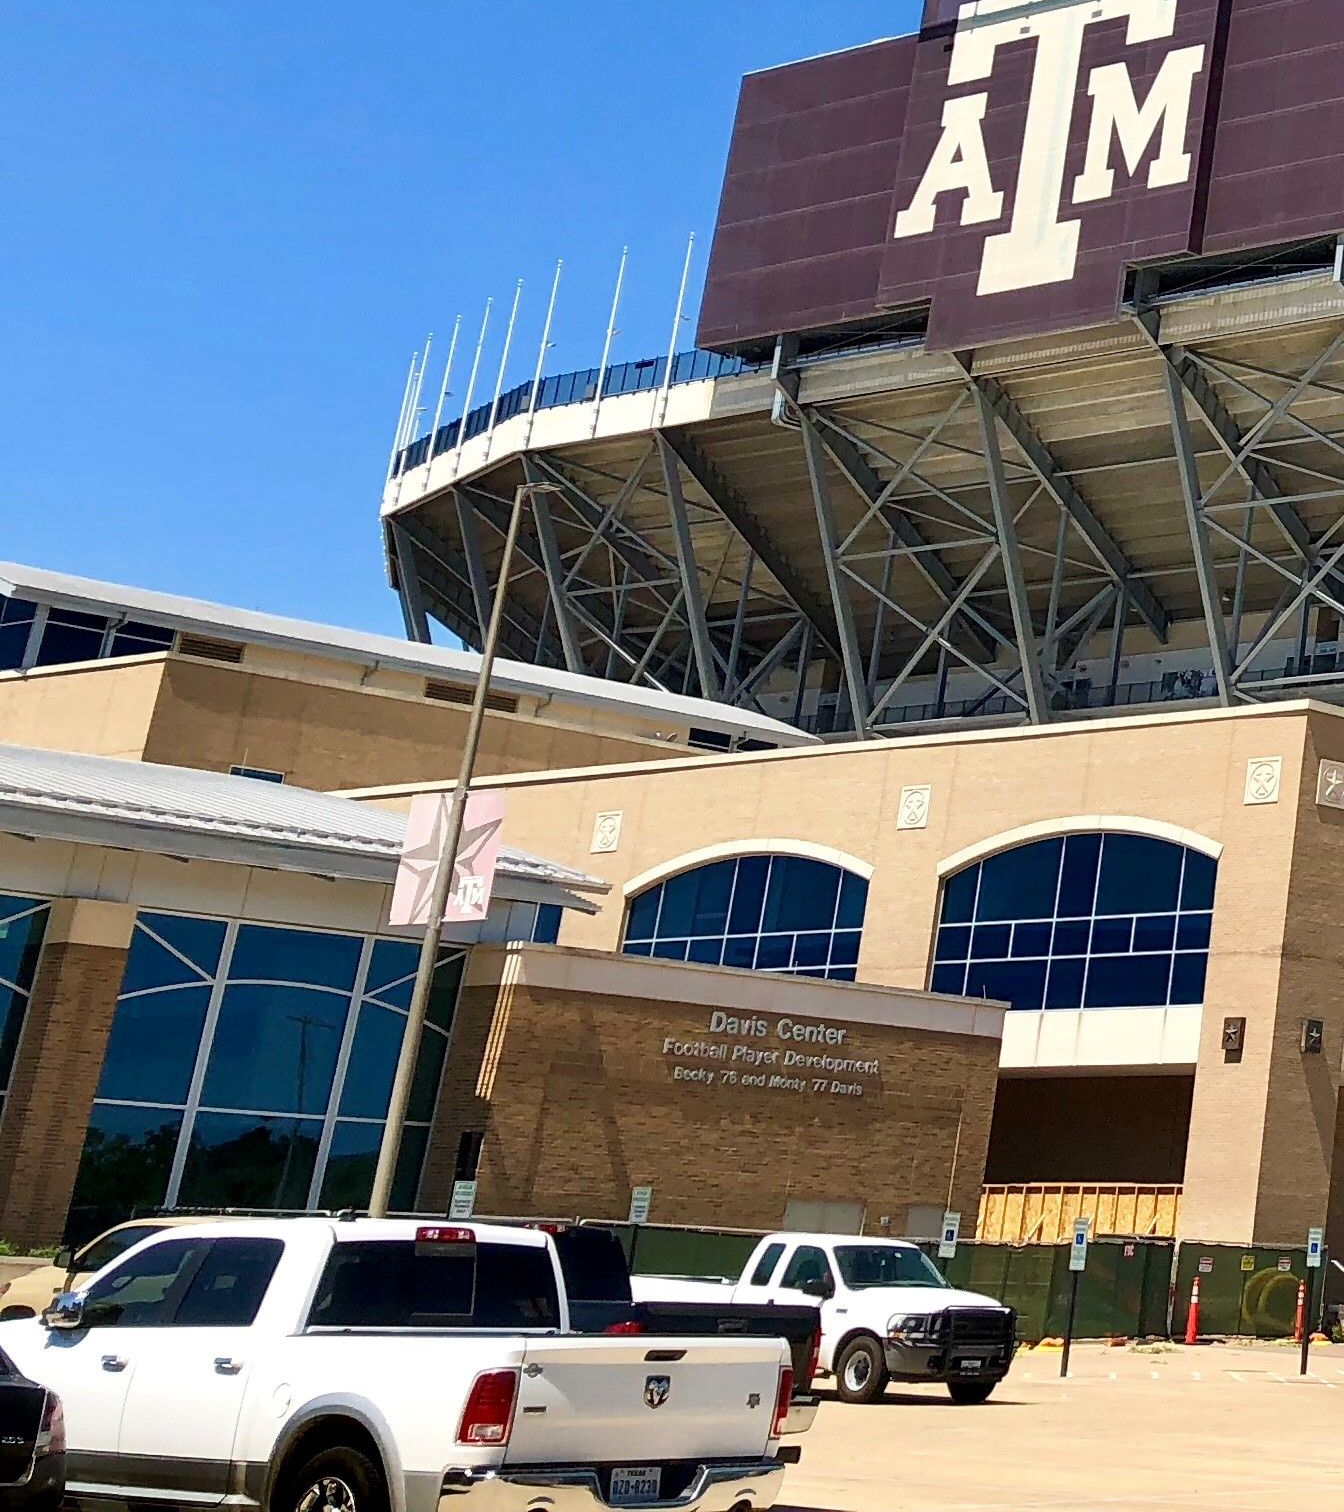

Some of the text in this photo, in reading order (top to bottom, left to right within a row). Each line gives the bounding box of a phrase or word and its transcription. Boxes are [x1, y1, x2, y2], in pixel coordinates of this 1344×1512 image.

[709, 1011, 847, 1045] Davis Center
[662, 1038, 879, 1074] Football Player Development
[673, 1066, 715, 1085] Becky
[741, 1074, 765, 1087] and
[769, 1074, 806, 1092] Monty
[831, 1080, 863, 1096] Davis
